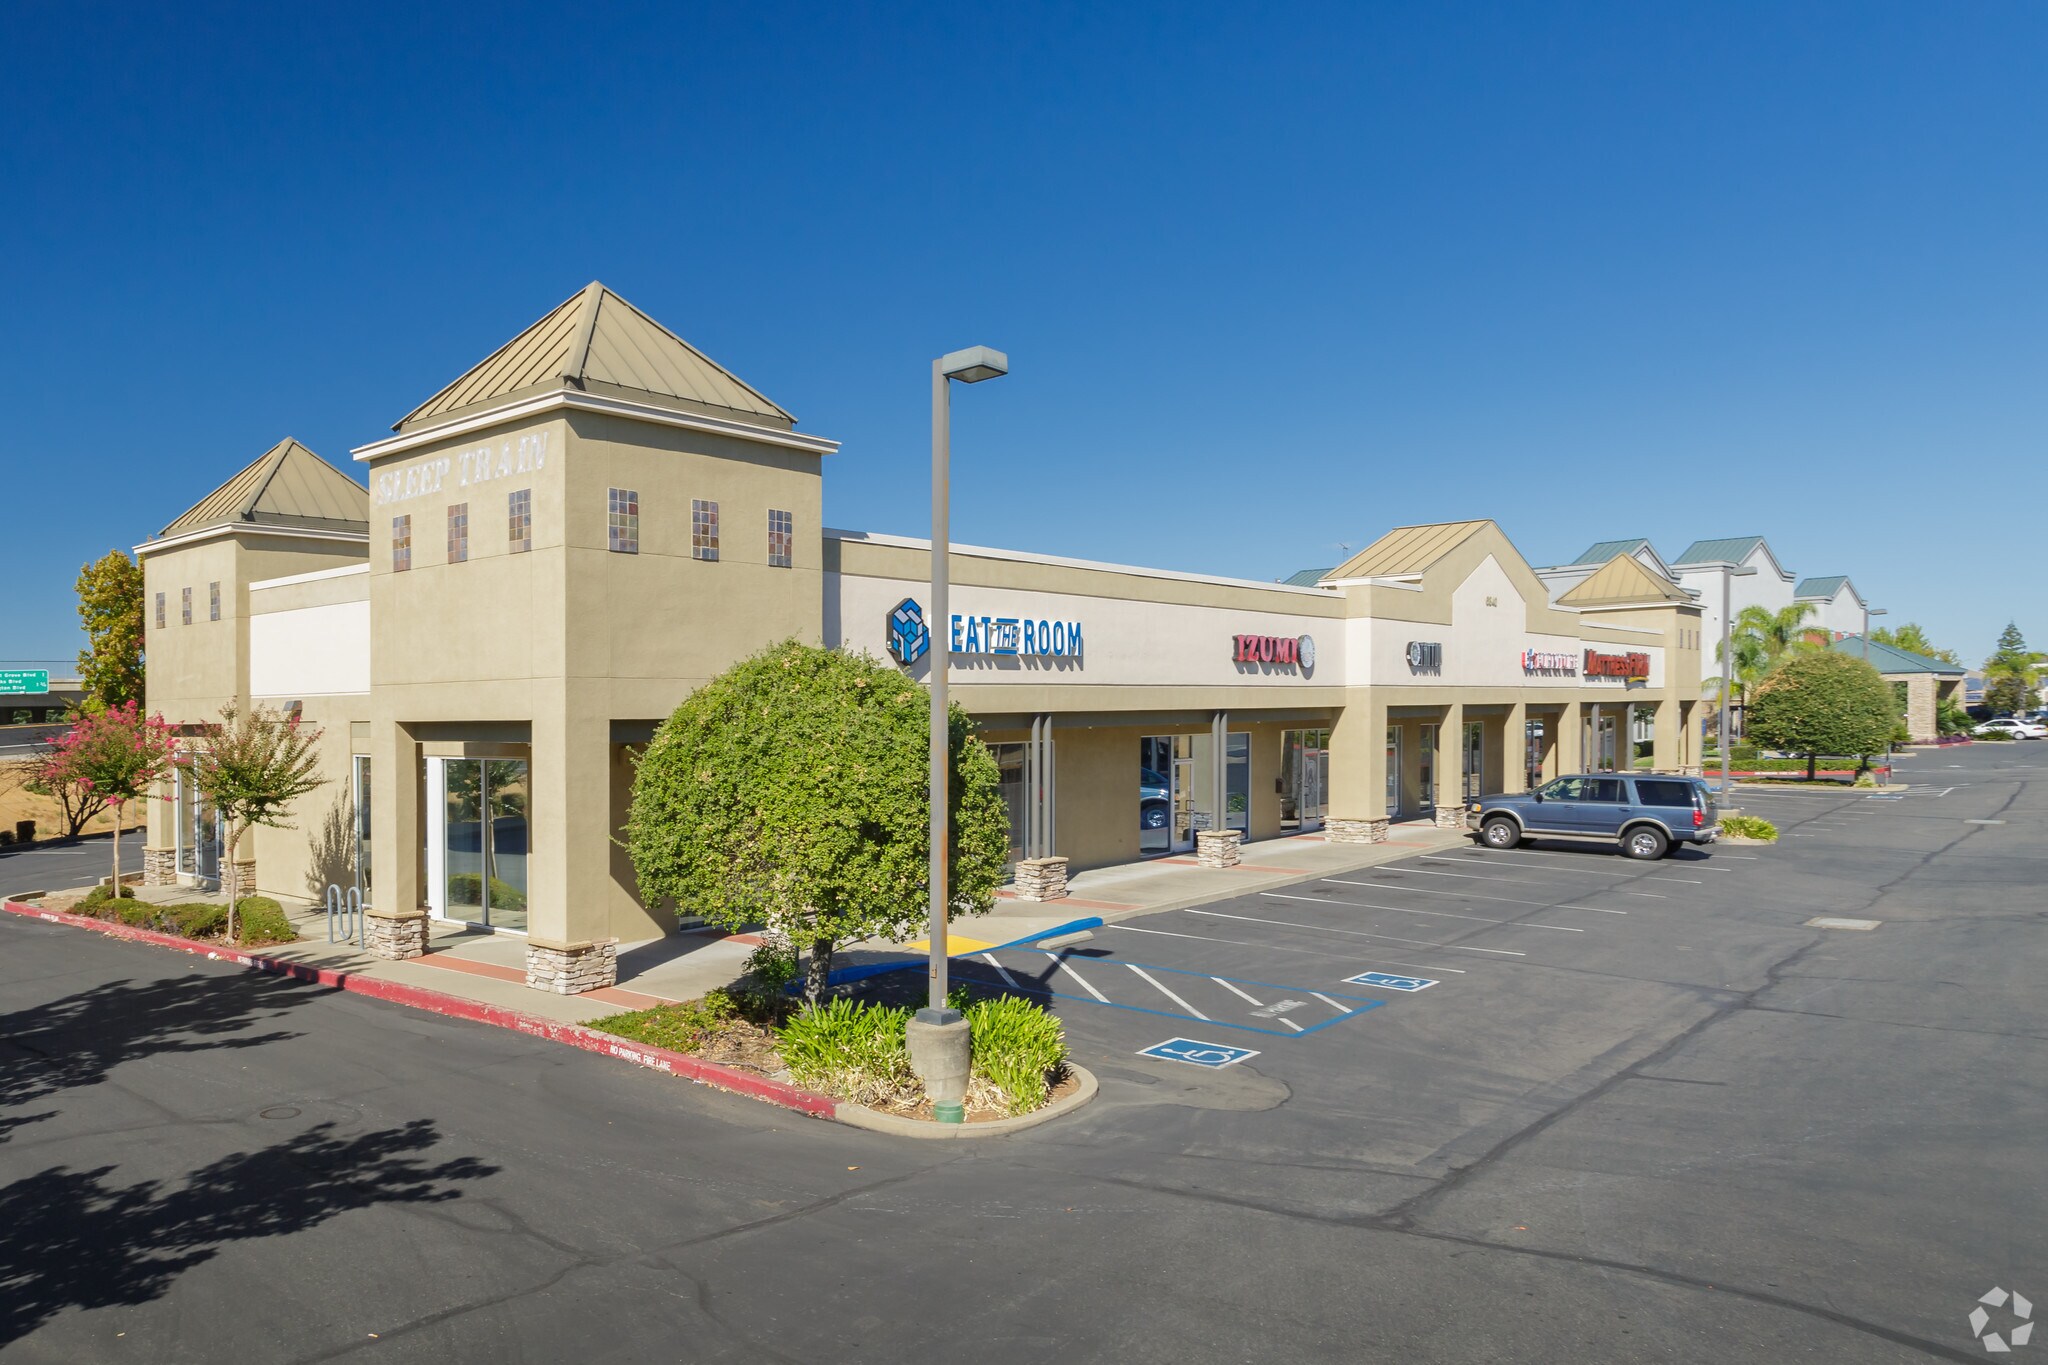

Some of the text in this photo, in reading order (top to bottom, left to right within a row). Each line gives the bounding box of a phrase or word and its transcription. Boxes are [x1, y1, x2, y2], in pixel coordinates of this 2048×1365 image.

[377, 431, 549, 506] SLEEP TRAIN
[950, 614, 1082, 656] EAT THE ROOM
[1237, 634, 1298, 663] IZUMI
[609, 1044, 671, 1072] NO PARKING FIRE LANE
